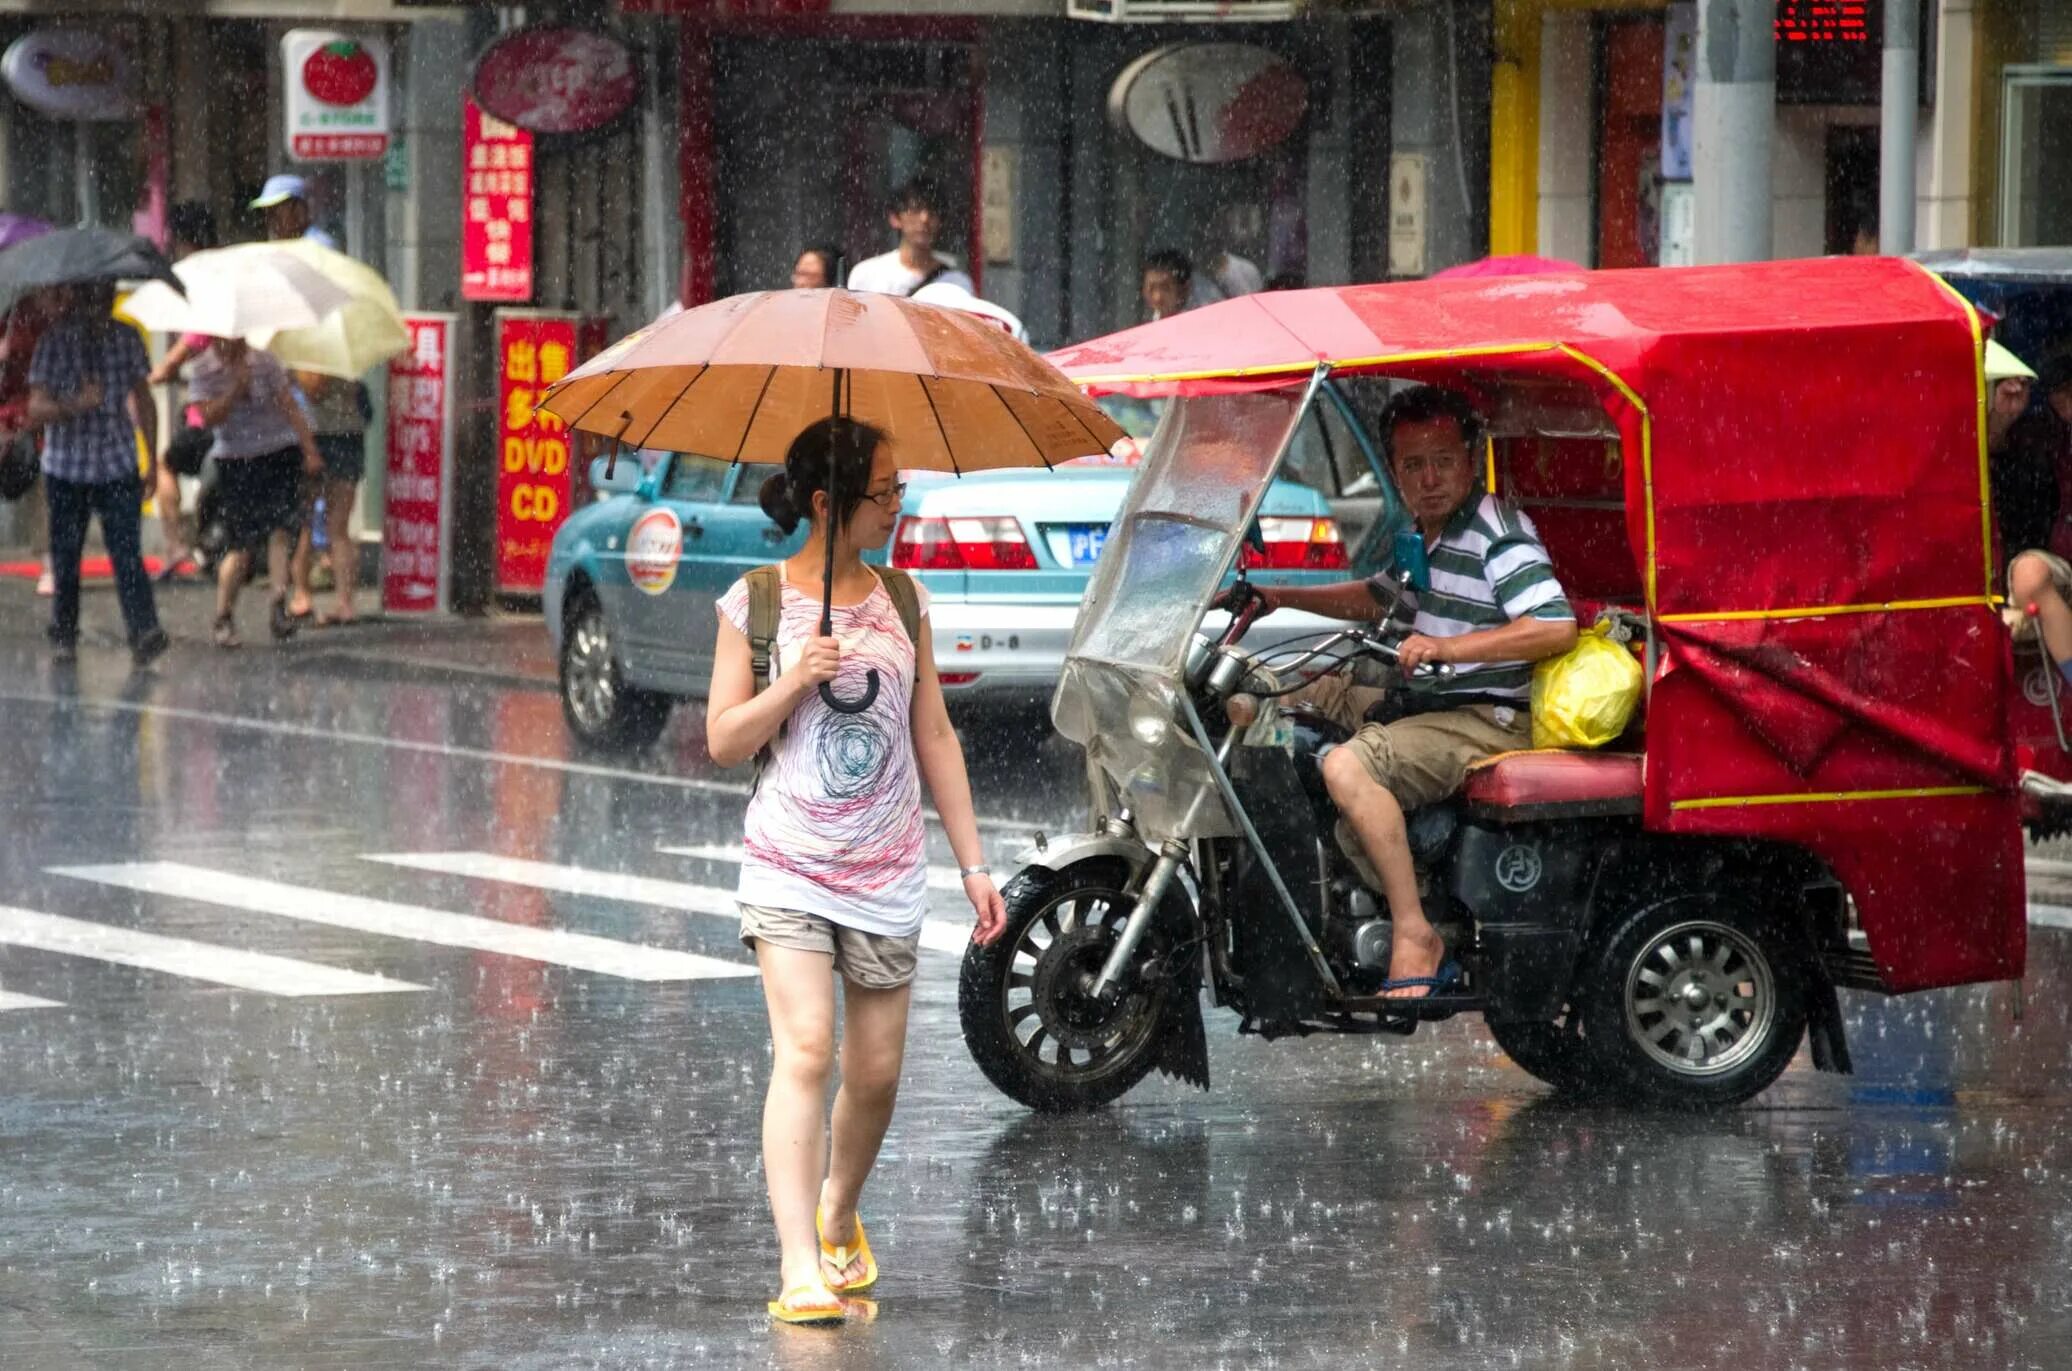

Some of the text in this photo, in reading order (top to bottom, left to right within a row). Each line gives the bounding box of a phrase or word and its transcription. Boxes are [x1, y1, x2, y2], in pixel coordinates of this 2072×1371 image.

[506, 339, 569, 383] 出售
[504, 436, 567, 475] DVD
[511, 483, 558, 521] CD
